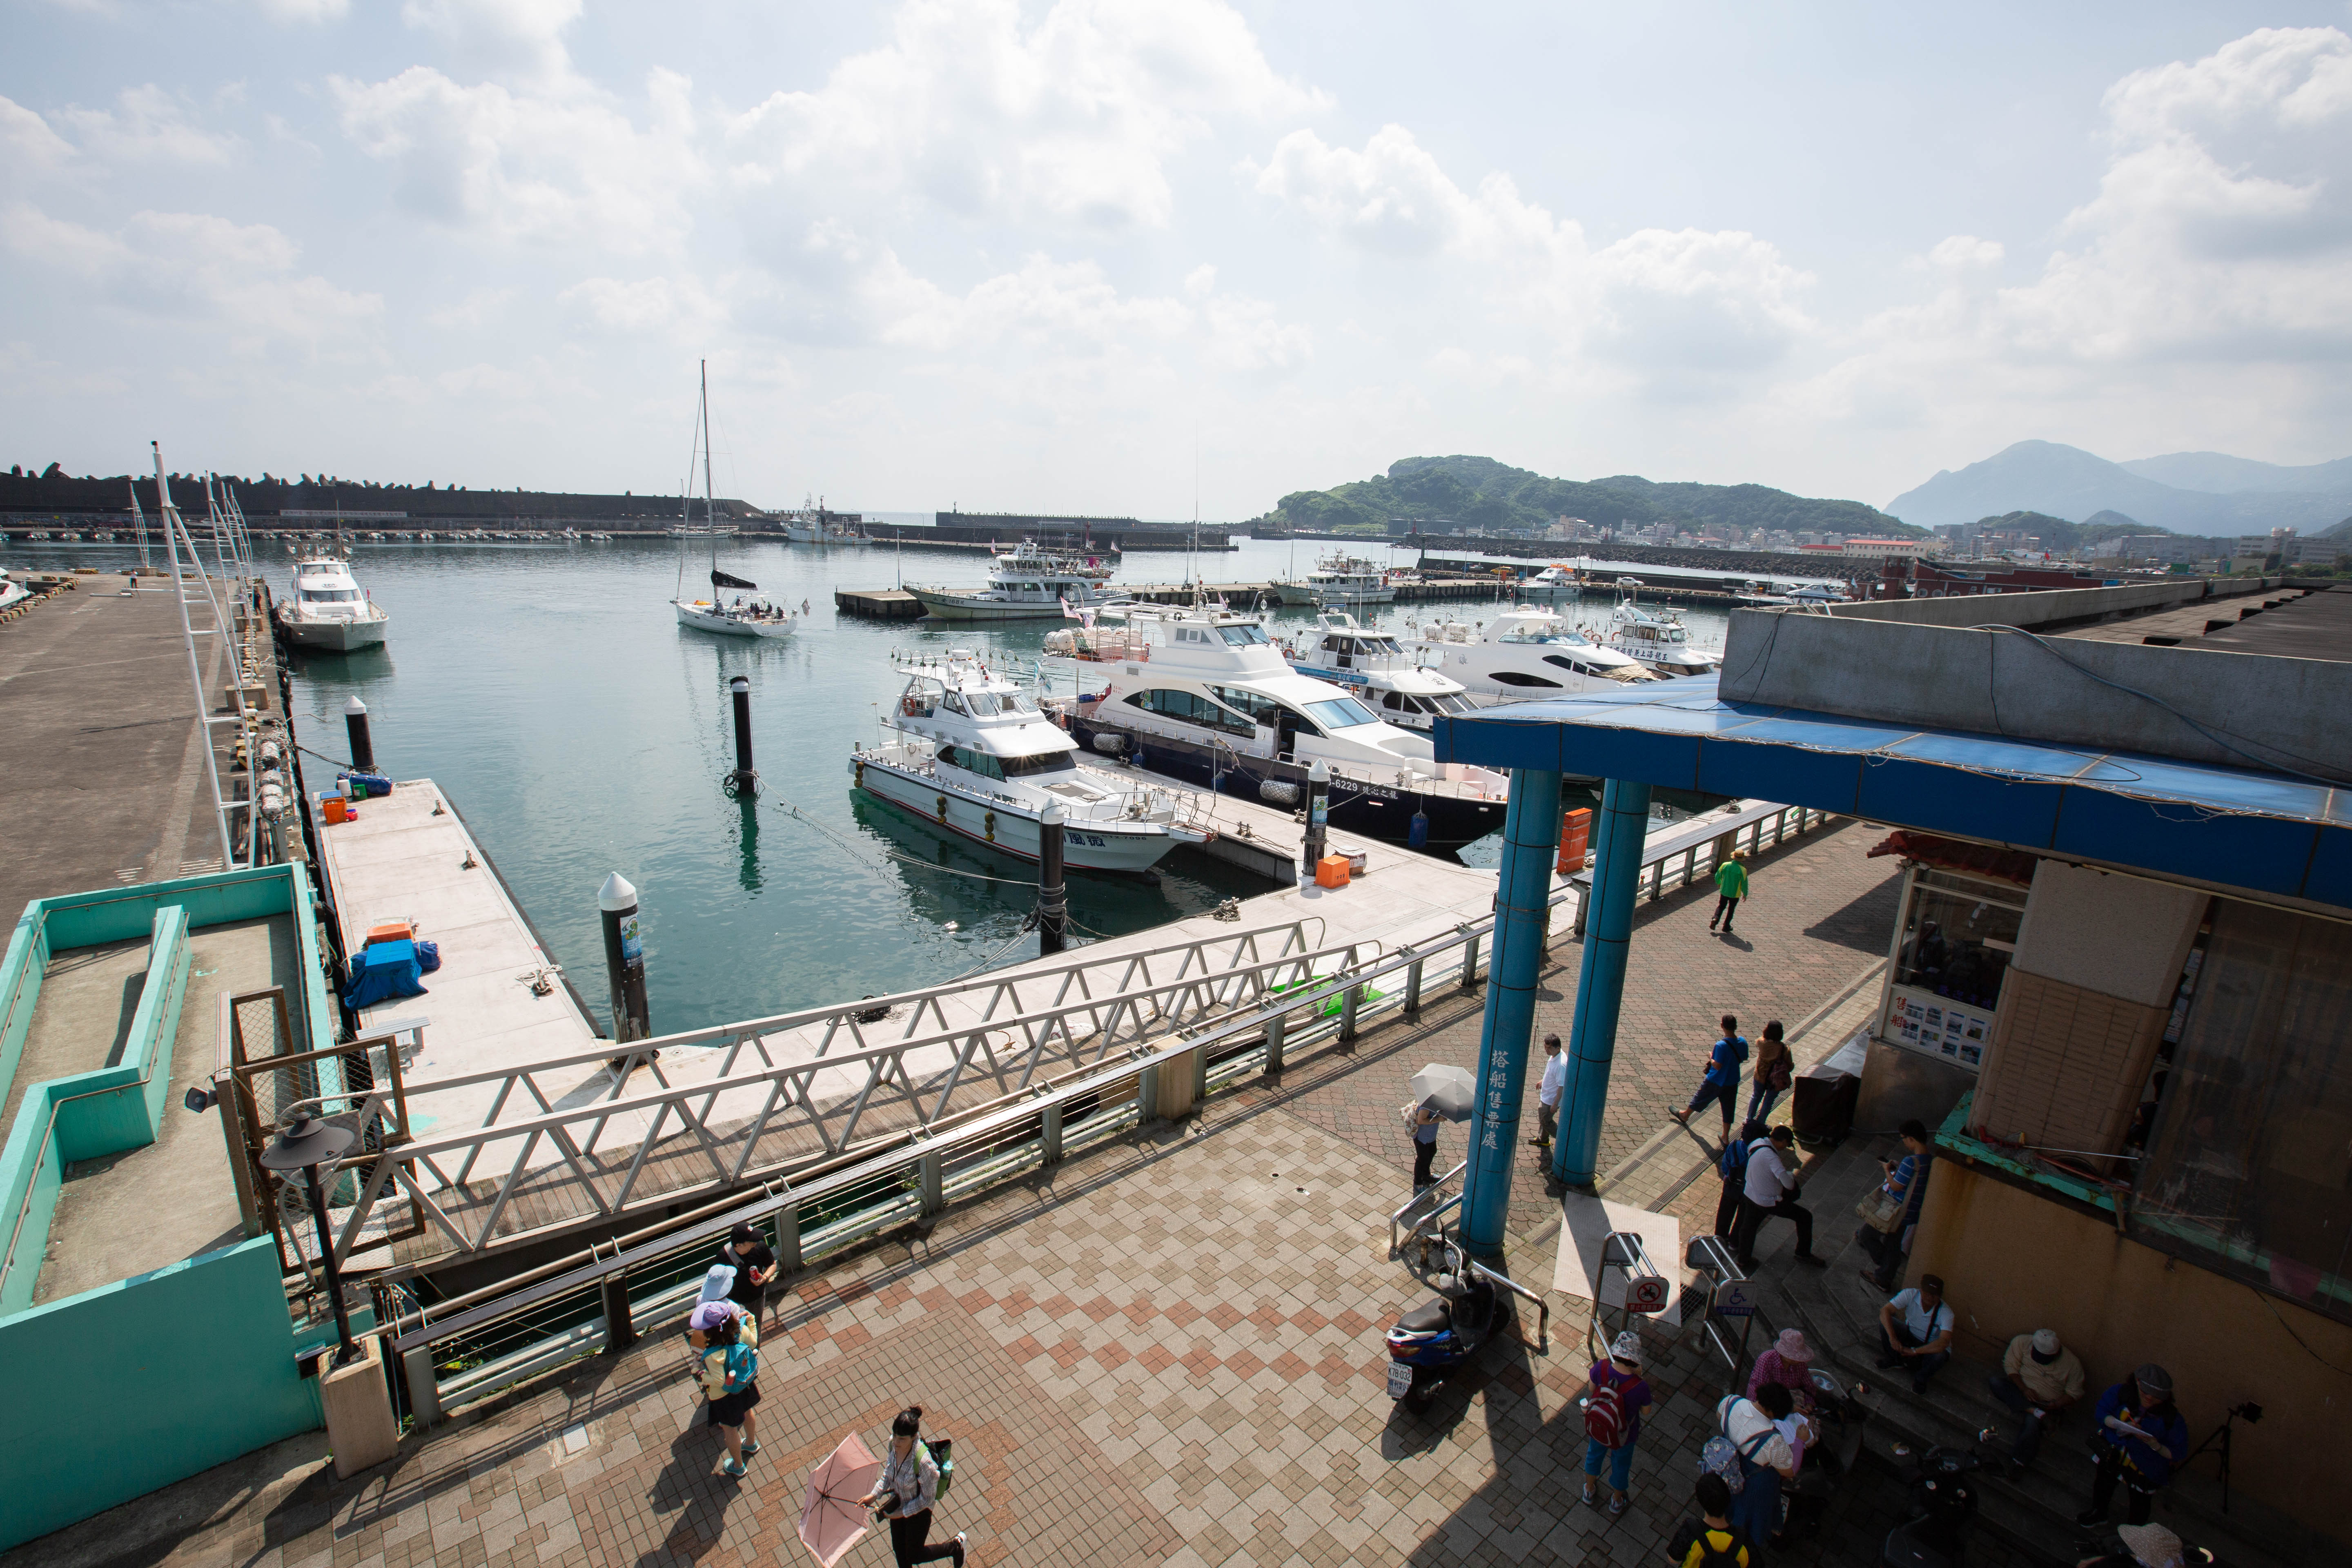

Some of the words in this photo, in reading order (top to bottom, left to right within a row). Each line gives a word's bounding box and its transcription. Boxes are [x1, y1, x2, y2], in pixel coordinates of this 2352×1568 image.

[1481, 1049, 1510, 1150] 搭船售票處
